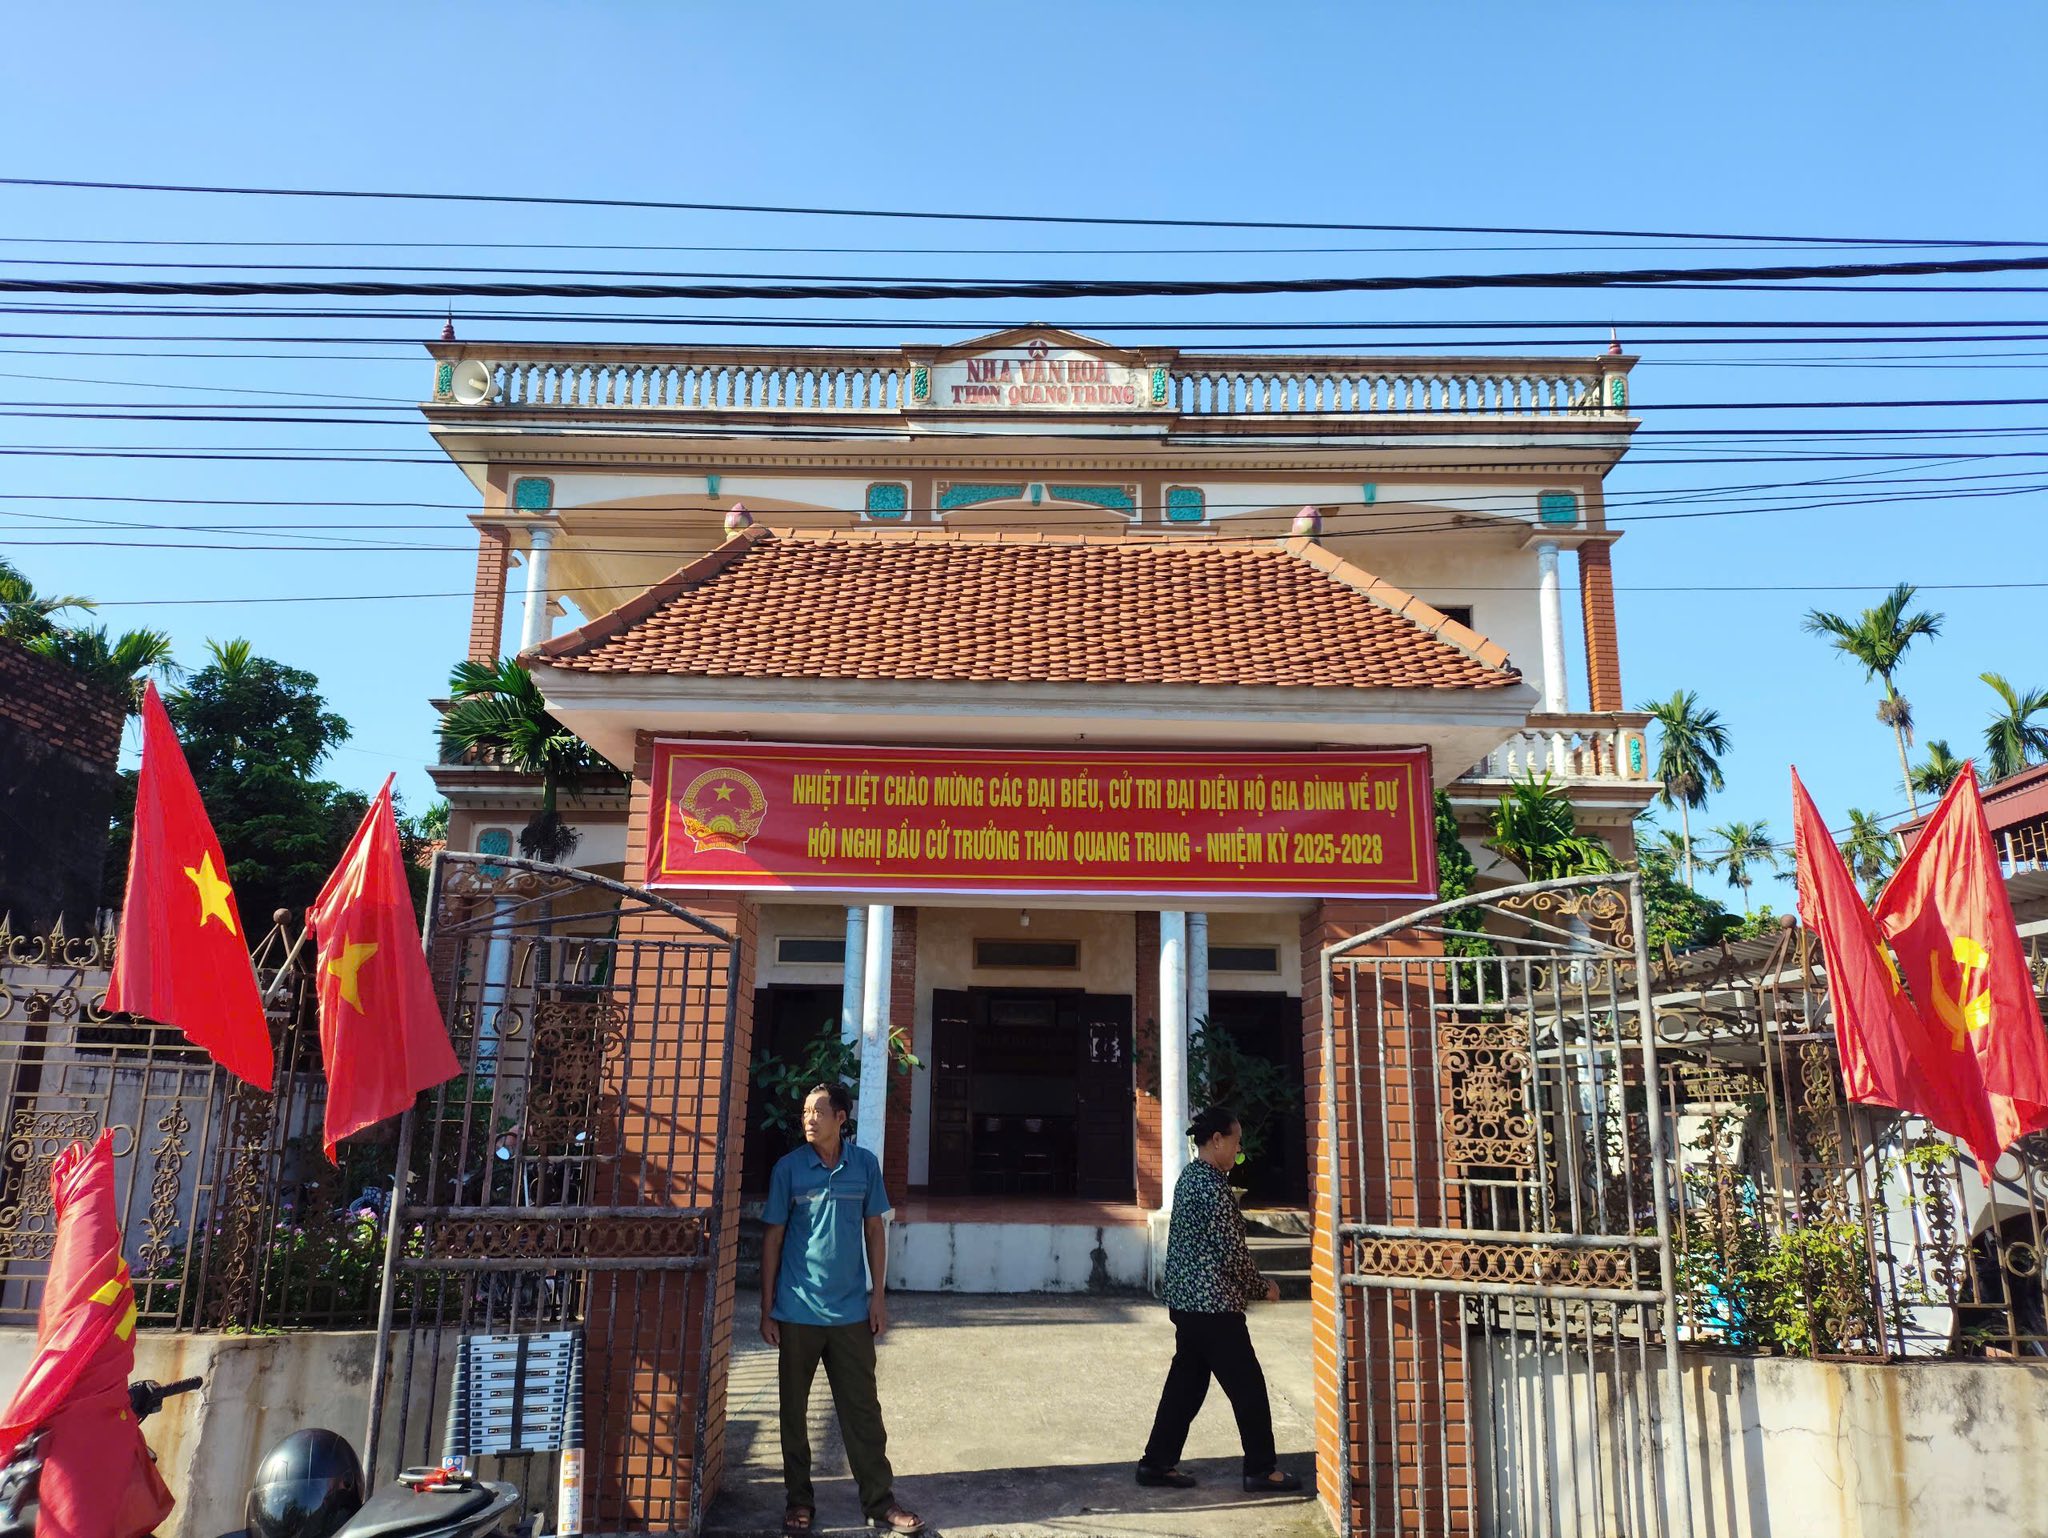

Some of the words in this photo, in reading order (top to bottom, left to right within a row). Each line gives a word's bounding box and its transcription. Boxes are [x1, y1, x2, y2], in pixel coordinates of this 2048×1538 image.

[1007, 385, 1068, 405] QUANG
[1071, 385, 1136, 405] TRUNG
[793, 769, 841, 811] NHIỆT
[845, 769, 880, 811] LIỆT
[884, 773, 928, 806] CHÀO
[933, 770, 984, 807] MỪNG
[989, 772, 1023, 808] CÁC
[1027, 777, 1056, 814] ĐẠI
[1061, 768, 1104, 812] BIỂU,
[1109, 770, 1132, 809] CỬ
[1136, 779, 1162, 809] TRI
[1166, 780, 1195, 816] ĐẠI
[1199, 774, 1239, 817] DIỆN
[1243, 774, 1266, 817] HỘ
[1271, 780, 1300, 810] GIA
[1303, 774, 1345, 810] ĐÌNH
[1348, 772, 1371, 811] VỀ
[1375, 778, 1400, 817] DỰ
[807, 821, 836, 864] HỘI
[840, 828, 882, 865] NGHỊ
[886, 818, 921, 860] BẦU
[925, 820, 950, 860] CỬ
[953, 820, 1019, 861] TRƯỞNG
[1024, 824, 1068, 861] THÔN
[1073, 831, 1130, 864] QUANG
[1134, 832, 1191, 863] TRUNG
[1206, 827, 1263, 869] NHIỆM
[1267, 827, 1289, 863] KỲ
[1293, 833, 1384, 865] 2025-2028
